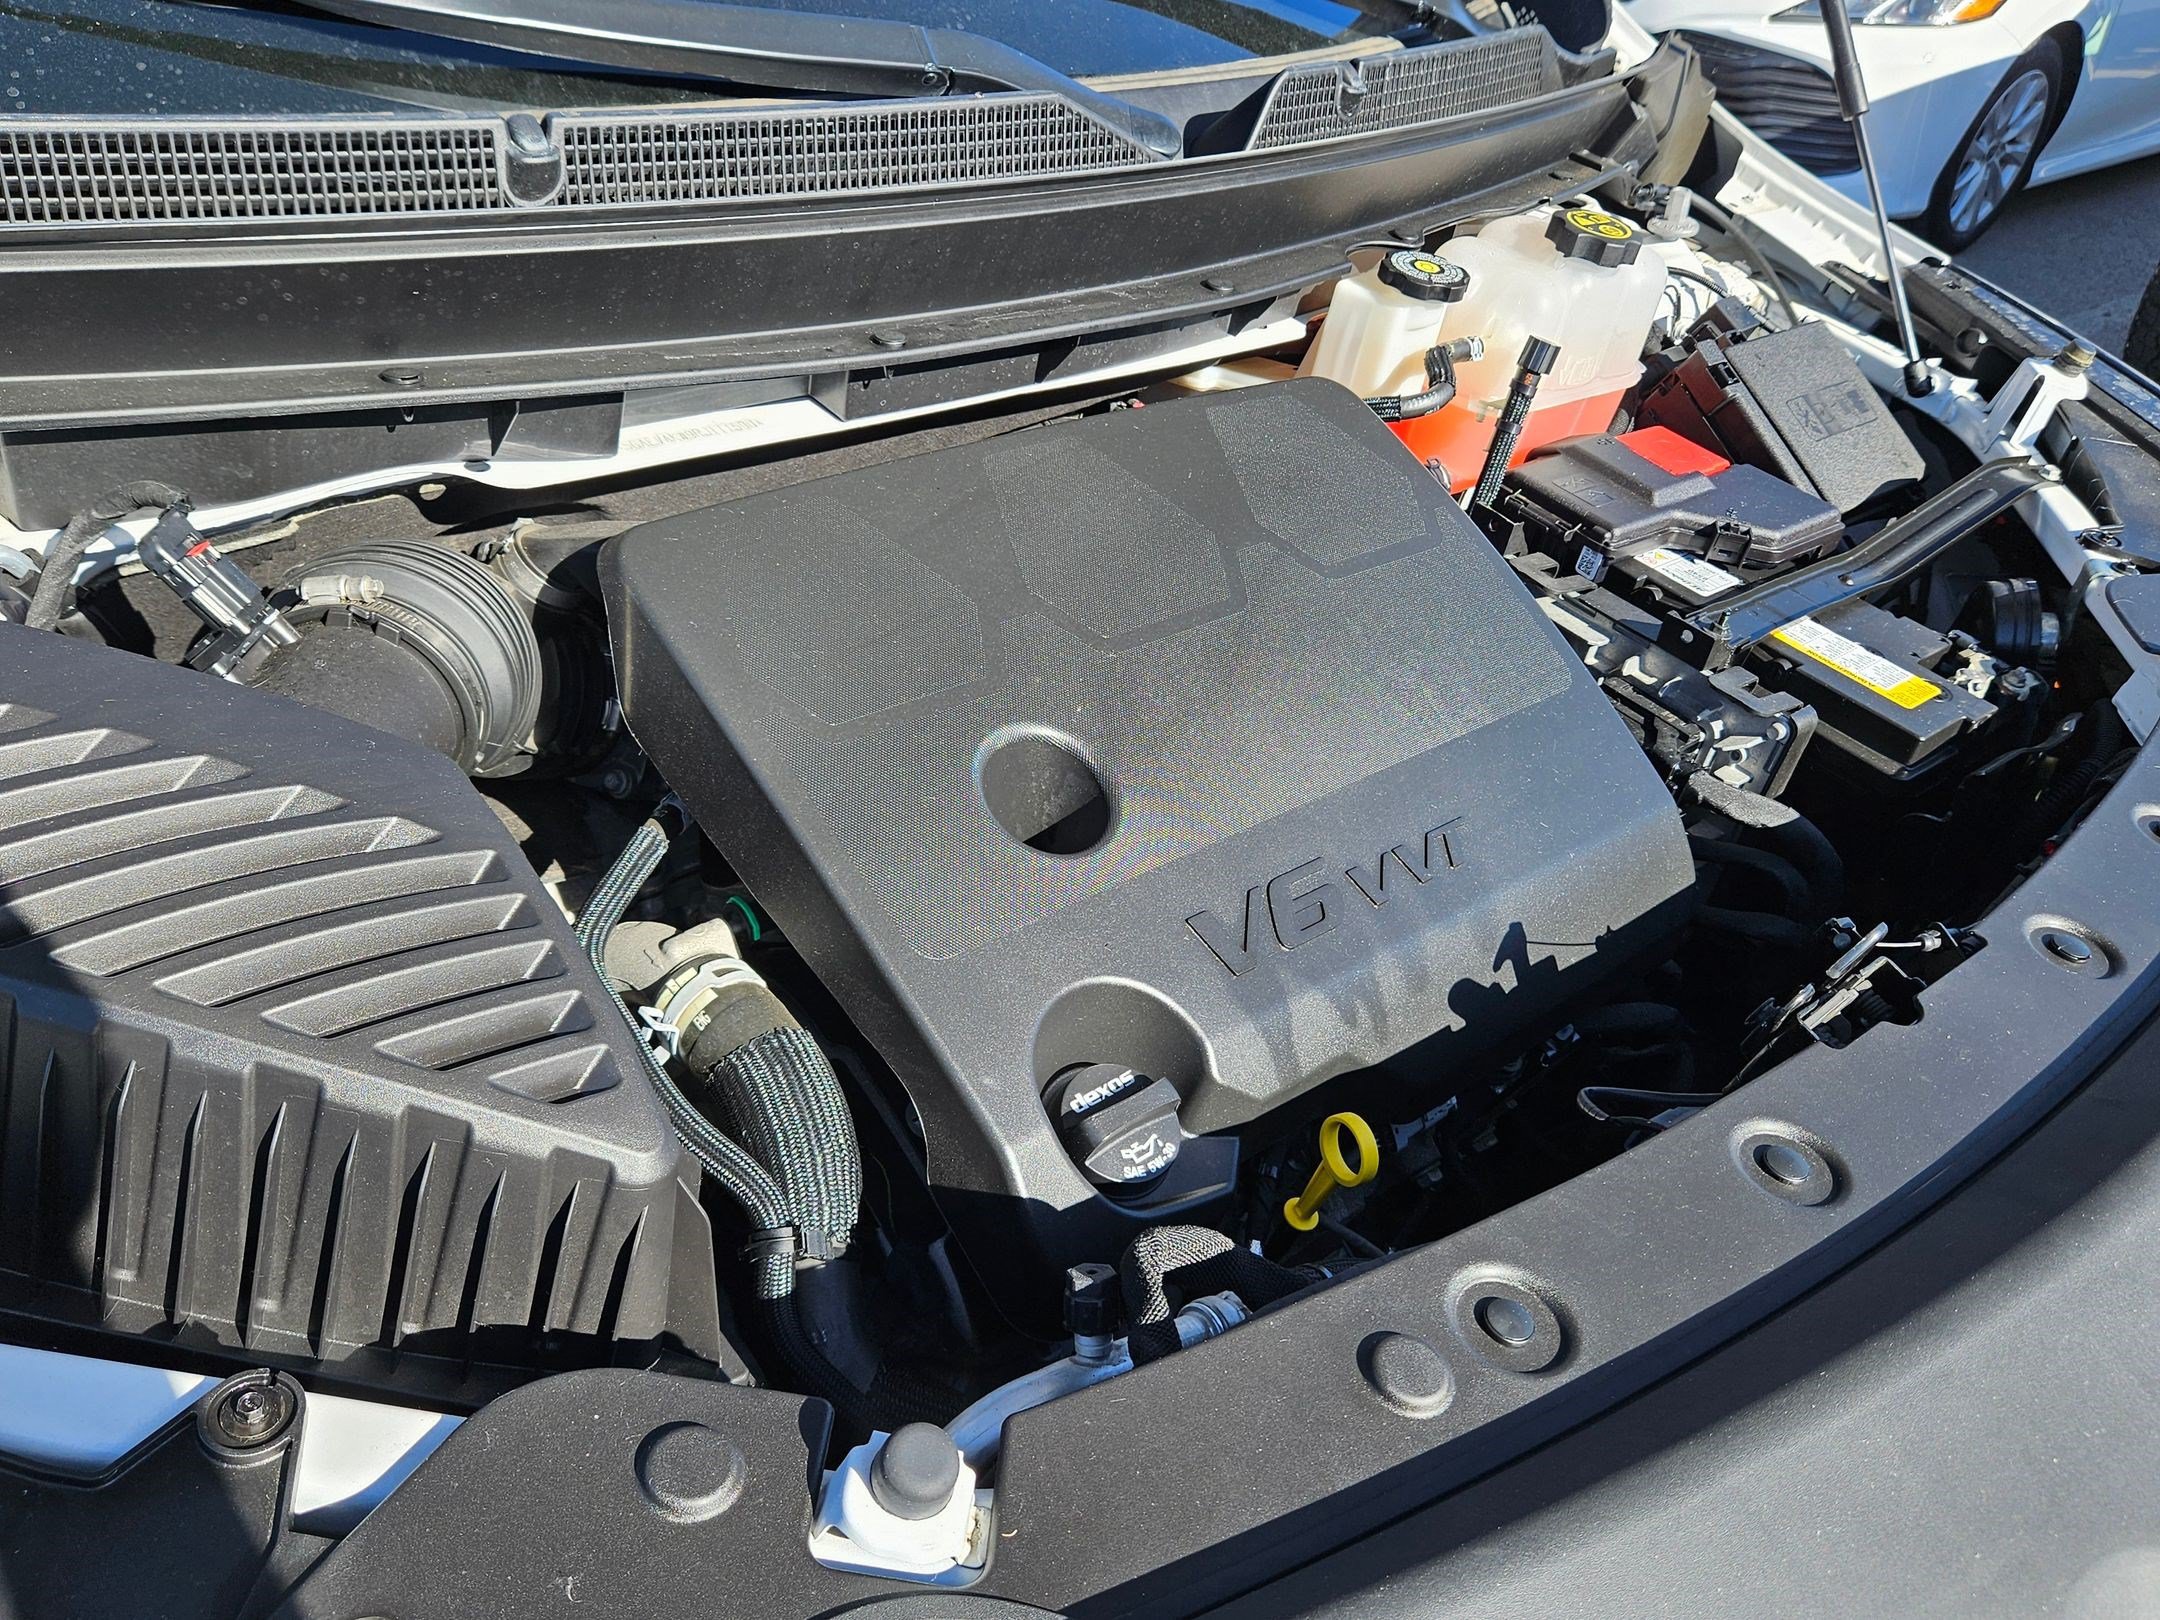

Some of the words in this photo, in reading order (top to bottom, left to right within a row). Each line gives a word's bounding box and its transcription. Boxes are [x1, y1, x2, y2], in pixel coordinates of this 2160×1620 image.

[1184, 856, 1341, 977] V6
[1344, 816, 1464, 909] VVT
[692, 1010, 712, 1032] ENG
[1069, 1068, 1136, 1114] dexos
[1122, 1162, 1148, 1180] SAE
[1147, 1142, 1177, 1175] 5W-30
